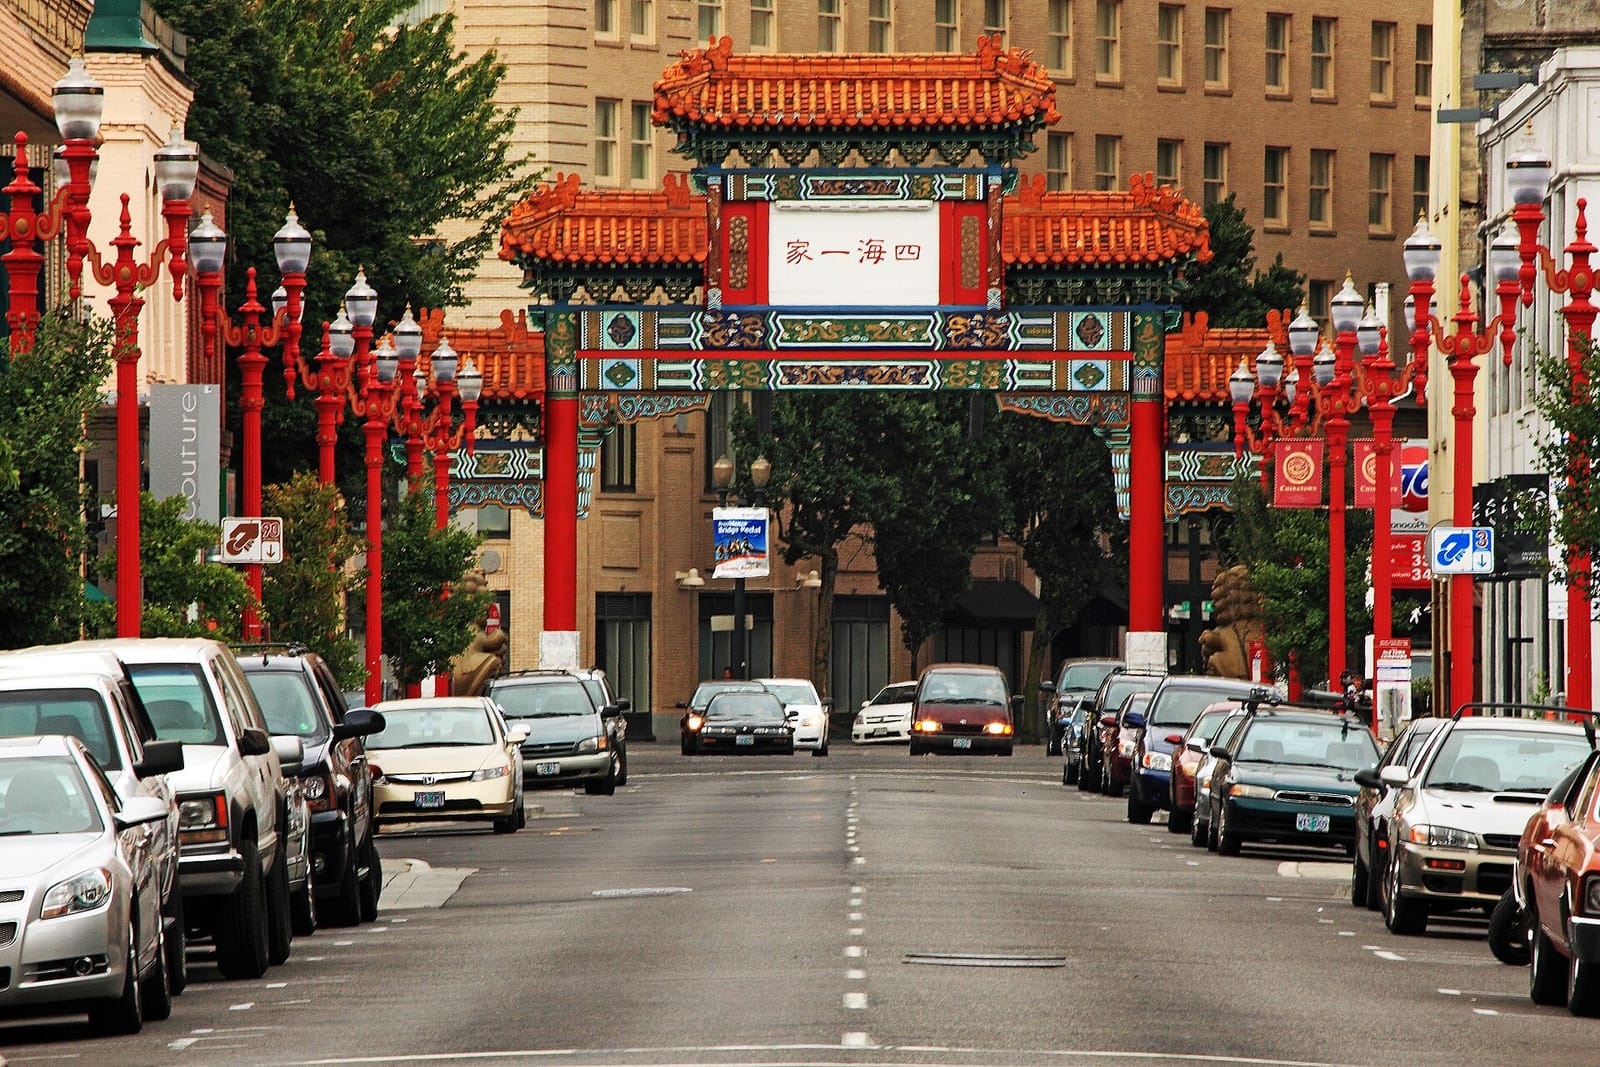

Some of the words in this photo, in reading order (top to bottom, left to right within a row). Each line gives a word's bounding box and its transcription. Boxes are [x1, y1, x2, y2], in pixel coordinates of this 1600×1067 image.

[180, 391, 198, 520] couture
[1400, 460, 1428, 498] 76
[261, 521, 280, 538] 90
[1475, 530, 1488, 548] 3
